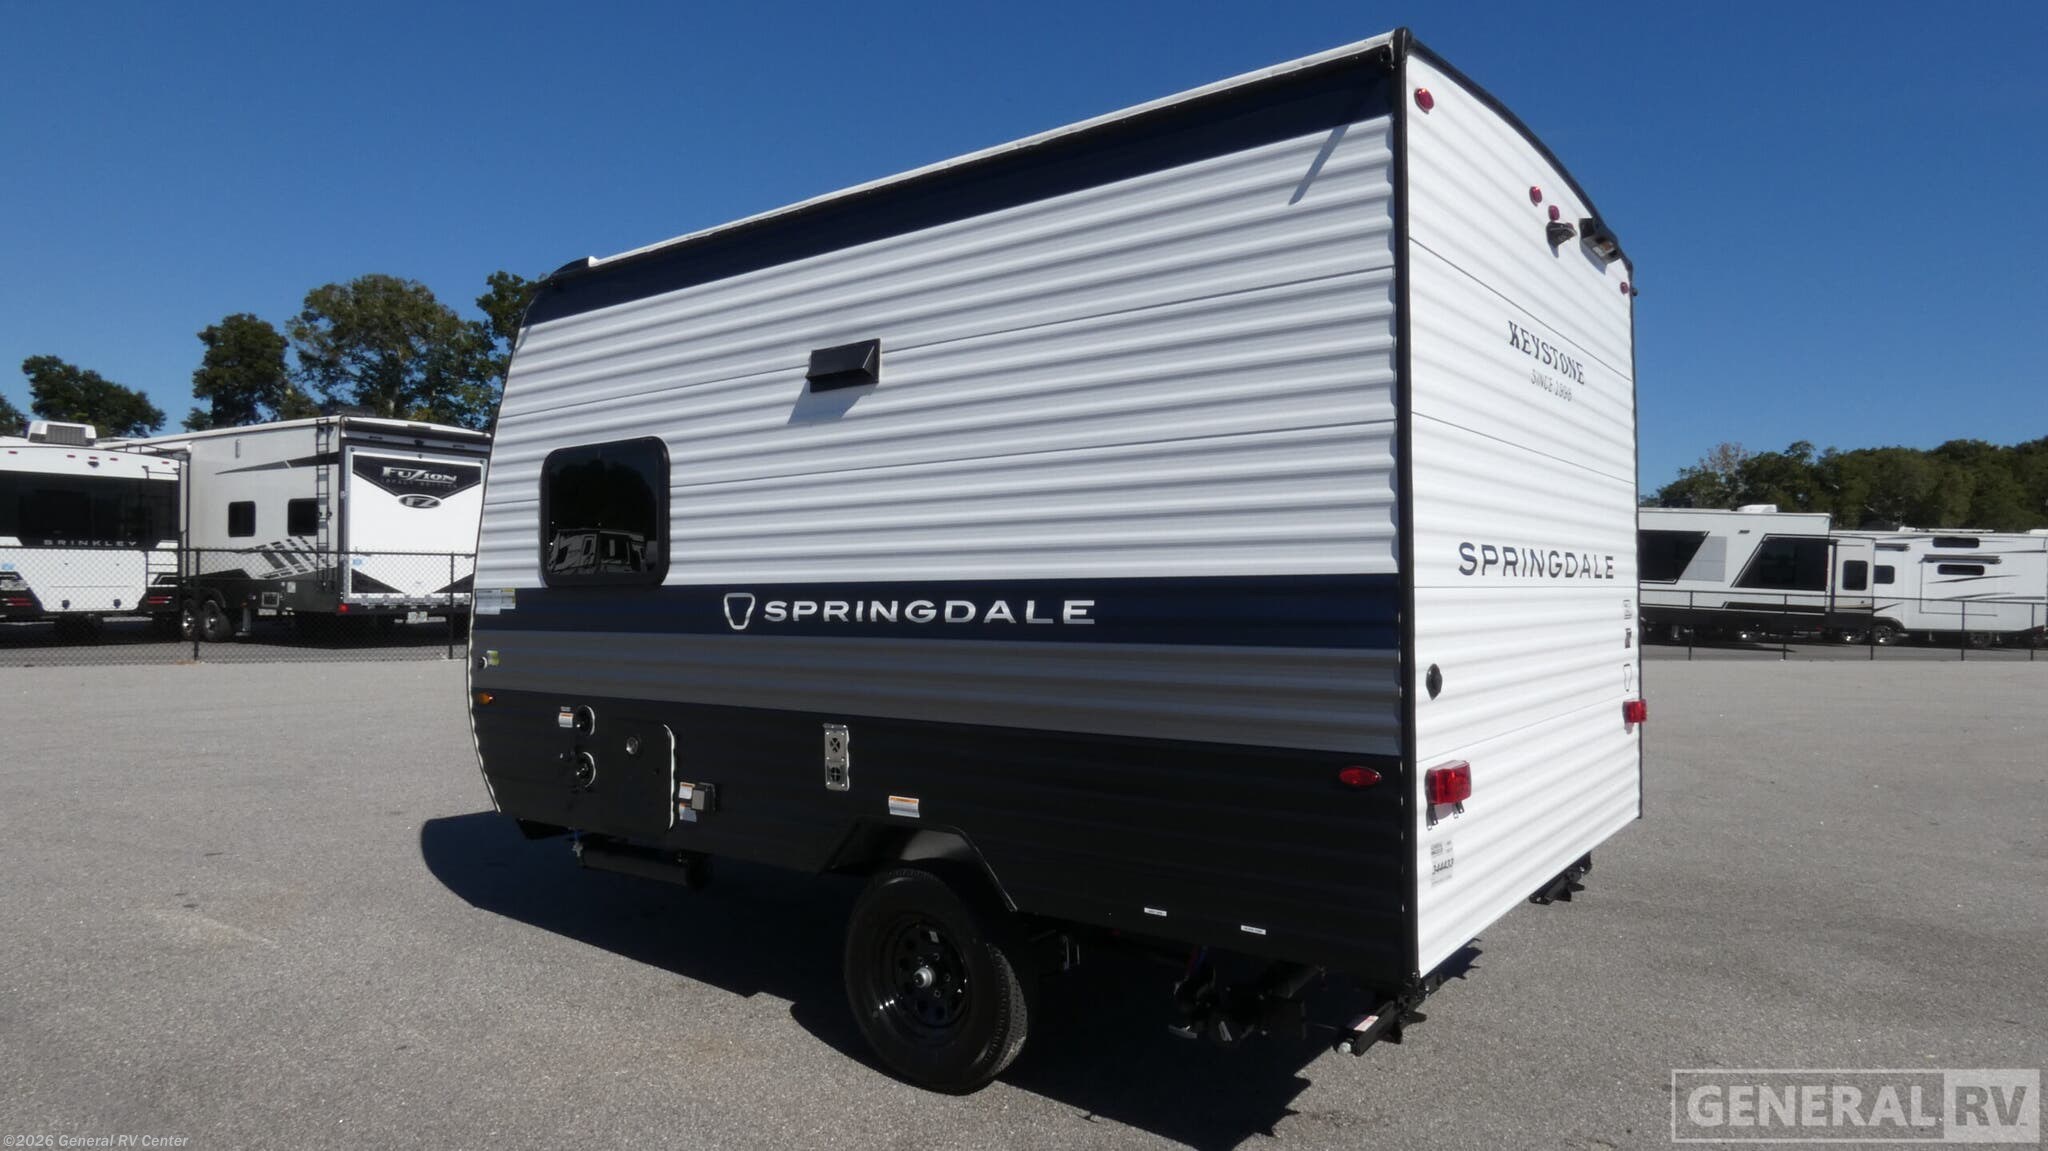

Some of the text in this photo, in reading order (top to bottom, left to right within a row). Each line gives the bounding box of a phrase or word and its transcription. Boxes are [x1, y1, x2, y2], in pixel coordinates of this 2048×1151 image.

[1508, 320, 1585, 385] KEYSTONE
[43, 539, 137, 547] BRINKLEY
[1458, 541, 1614, 580] SPRINGDALE
[763, 599, 1095, 625] SPRINGDALE
